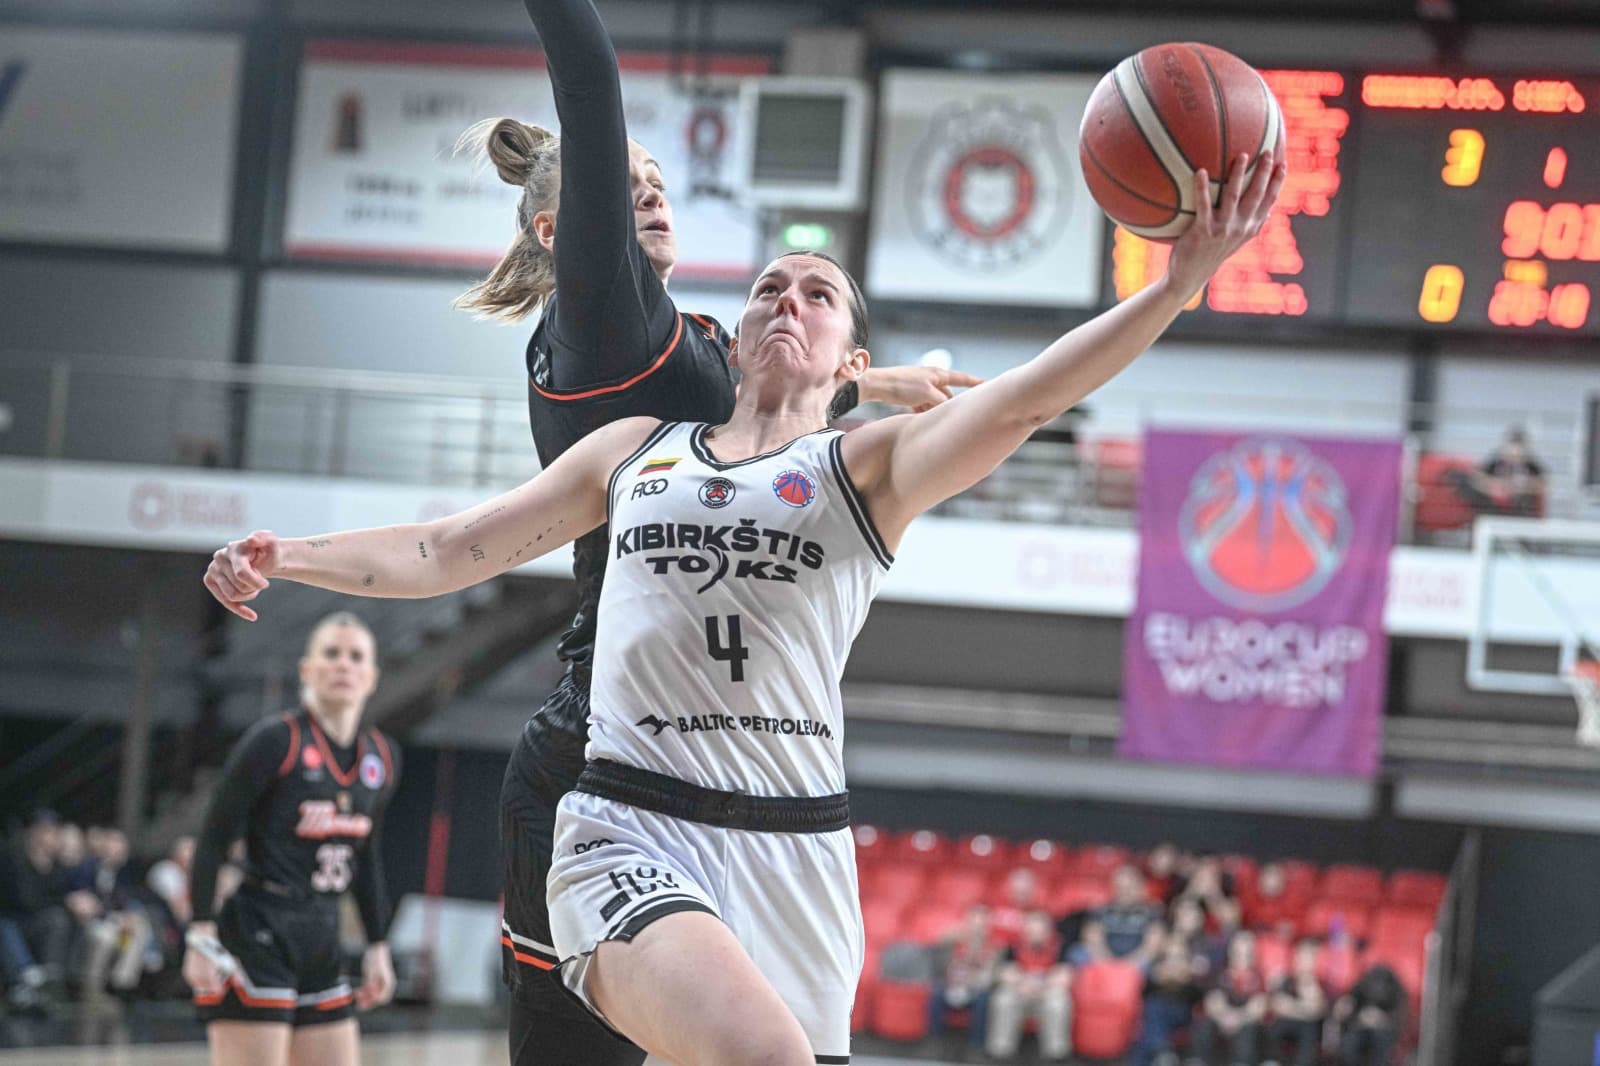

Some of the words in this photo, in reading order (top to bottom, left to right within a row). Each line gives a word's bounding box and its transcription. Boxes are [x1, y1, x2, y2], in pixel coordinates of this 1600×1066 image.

[616, 518, 825, 570] KIBIRKŠTIS
[705, 614, 749, 682] 4
[1143, 612, 1369, 666] EUROCUP
[1157, 656, 1346, 708] WOMEN
[677, 714, 737, 732] BALTIC
